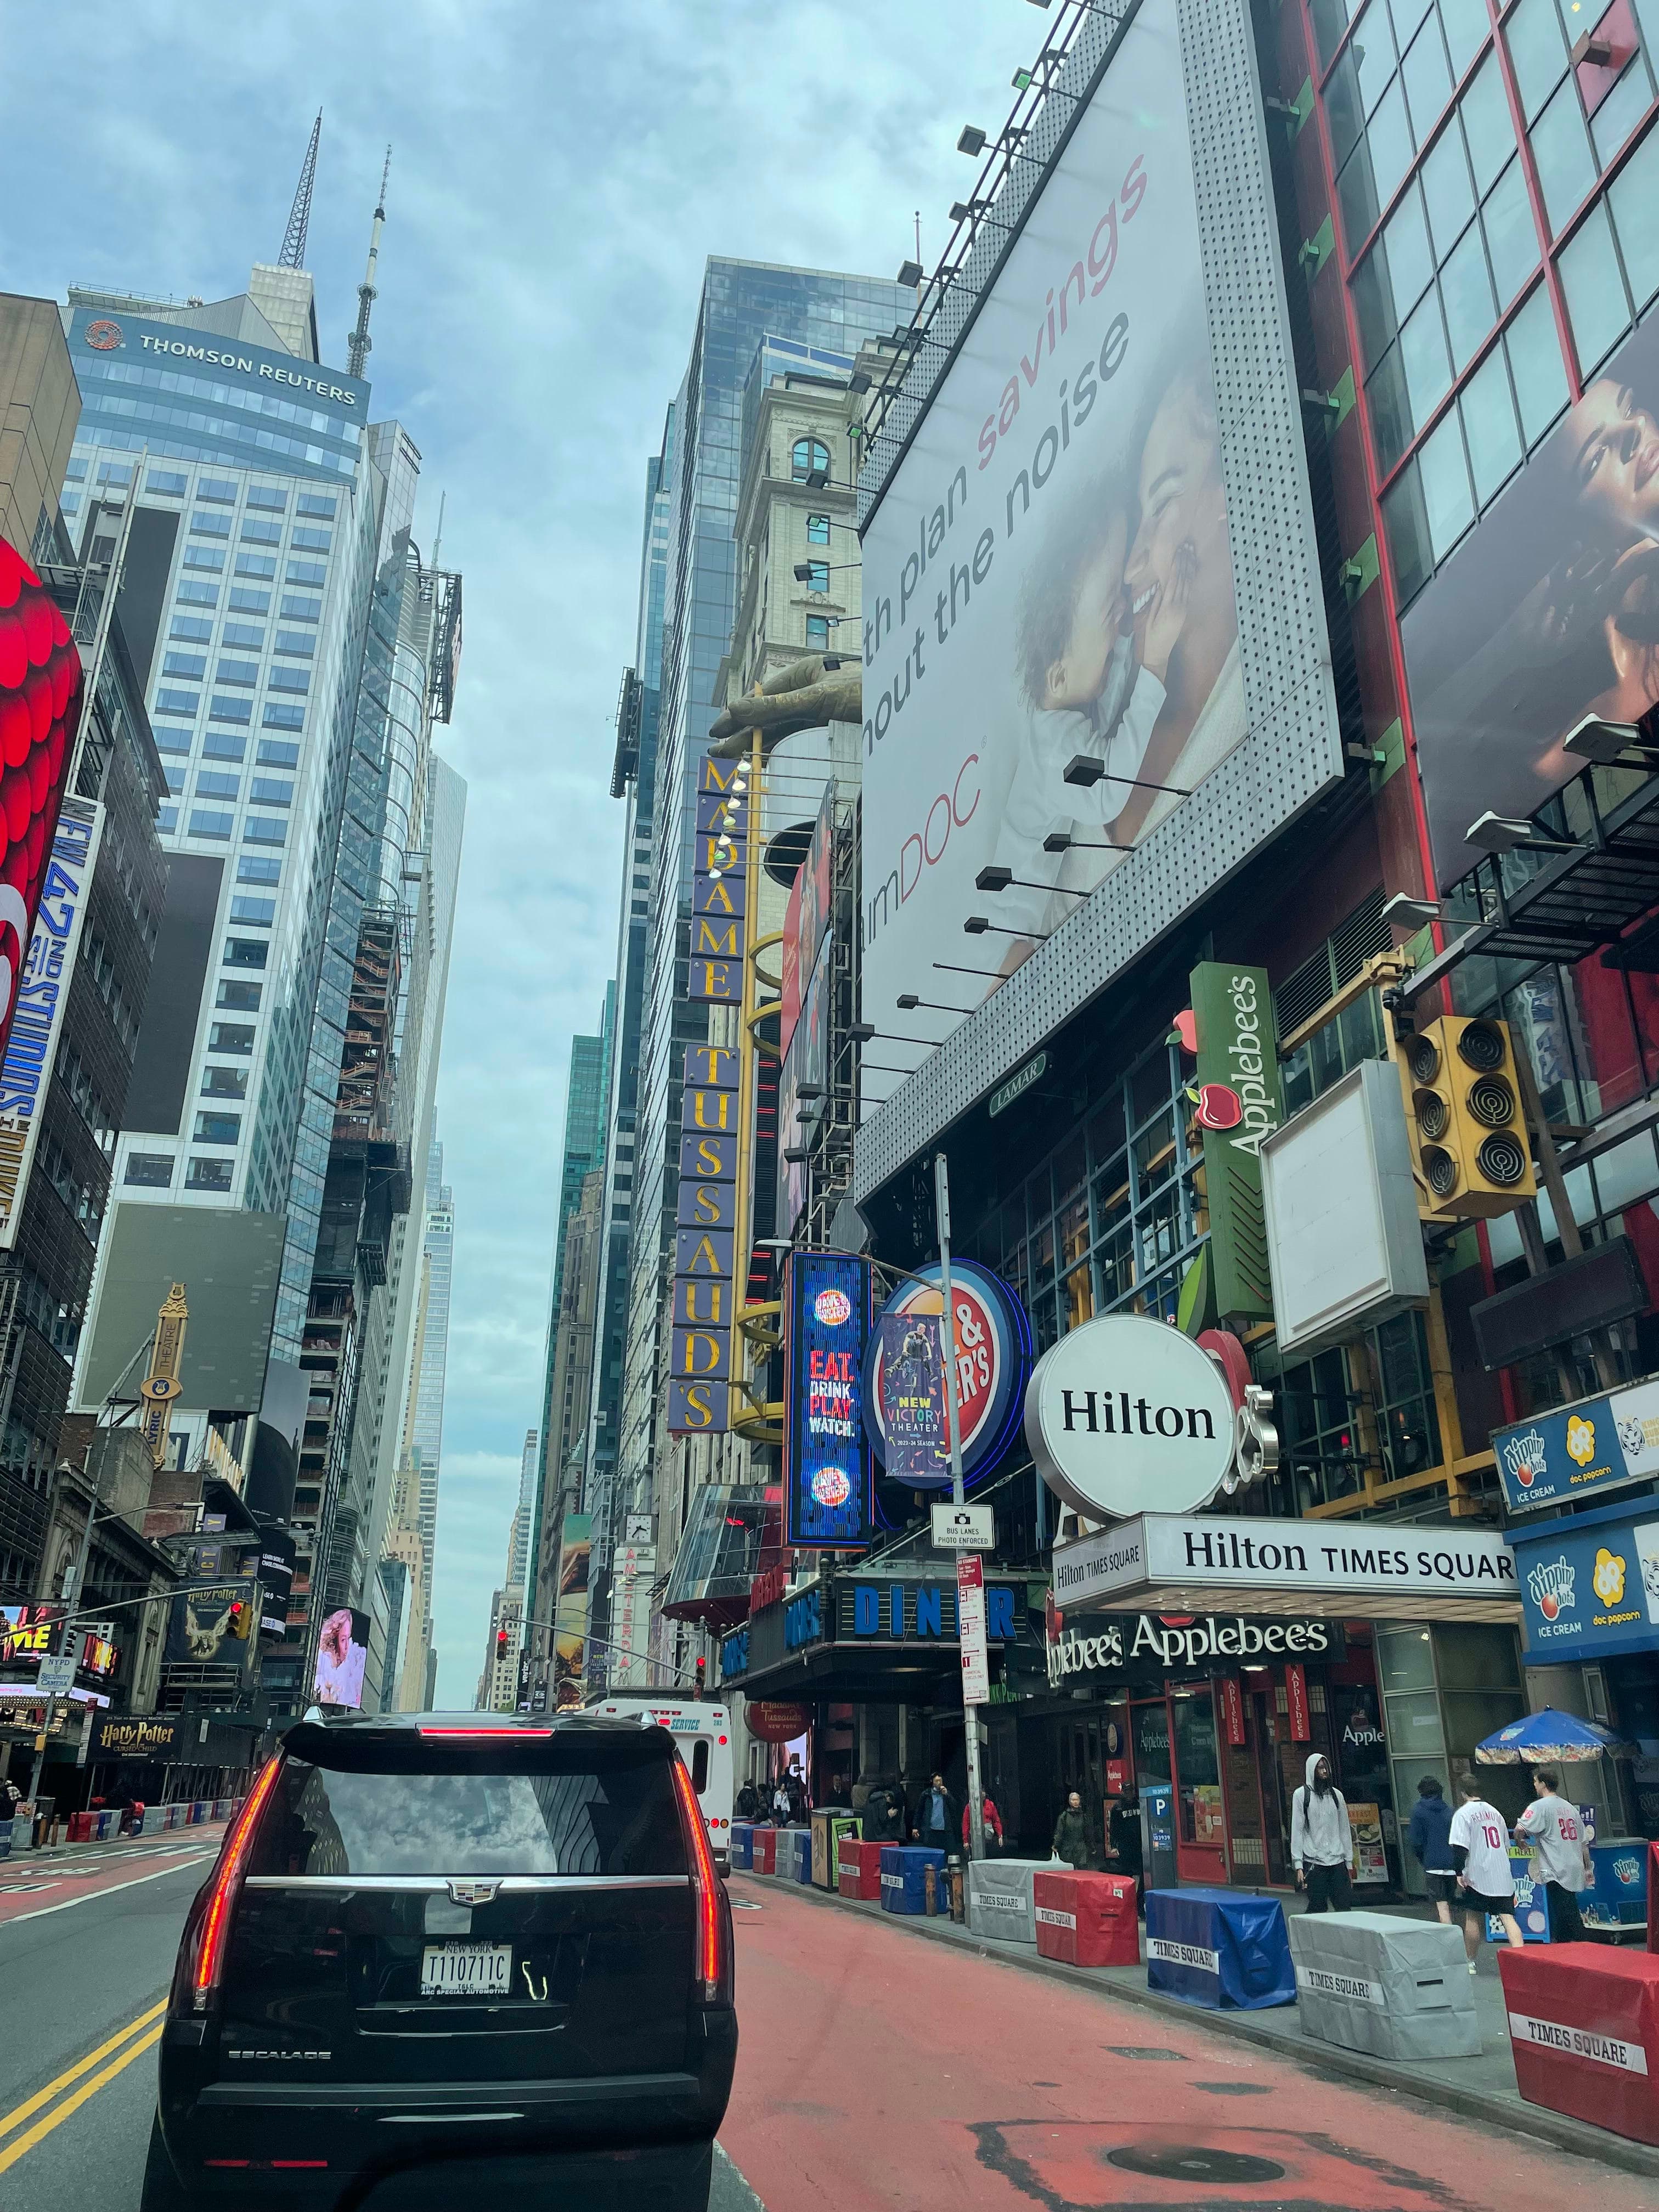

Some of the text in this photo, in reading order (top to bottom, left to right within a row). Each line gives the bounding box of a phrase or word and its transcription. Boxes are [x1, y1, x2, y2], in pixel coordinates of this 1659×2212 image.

[140, 335, 356, 405] THOMSON REUTERS
[901, 465, 968, 627] plan
[978, 154, 1147, 472] savings
[934, 527, 994, 645] the
[1006, 312, 1129, 534] noise
[696, 759, 739, 997] MADAME
[1228, 975, 1278, 1158] Applebee's
[997, 1062, 1037, 1108] LAMAR
[160, 1324, 176, 1369] THEATRE
[810, 1350, 855, 1381] EAT.
[899, 1397, 931, 1408] NEW
[1061, 1390, 1216, 1439] Hilton
[149, 1410, 161, 1445] LYRIC
[887, 1408, 941, 1424] VICTORY
[891, 1423, 938, 1432] THEATER
[1570, 1466, 1612, 1485] doc popcorn
[1516, 1485, 1555, 1504] ICE CREAM
[1057, 1545, 1139, 1589] Hilton TIMES SQUARE
[1183, 1532, 1519, 1582] Hilton TIMES SQUAR
[1538, 1622, 1582, 1638] ICE CREAM
[1593, 1610, 1641, 1627] doc popcorn
[1129, 1615, 1329, 1667] Applebee's
[670, 1718, 701, 1730] SERVICE
[761, 1708, 802, 1722] Tussauds
[100, 1722, 174, 1747] Harry Potter
[1155, 1799, 1166, 1815] P
[1482, 1826, 1501, 1849] 10
[979, 1894, 1018, 1908] TIMES SQUARE
[446, 1945, 492, 1954] NEW YORK
[1153, 1941, 1180, 1959] TIMES
[430, 1955, 505, 1982] T110711C
[1308, 1971, 1370, 1999] TIMES SQUARE
[228, 2050, 332, 2059] ESCALADE
[1528, 2021, 1628, 2066] TIMES SQUARE
